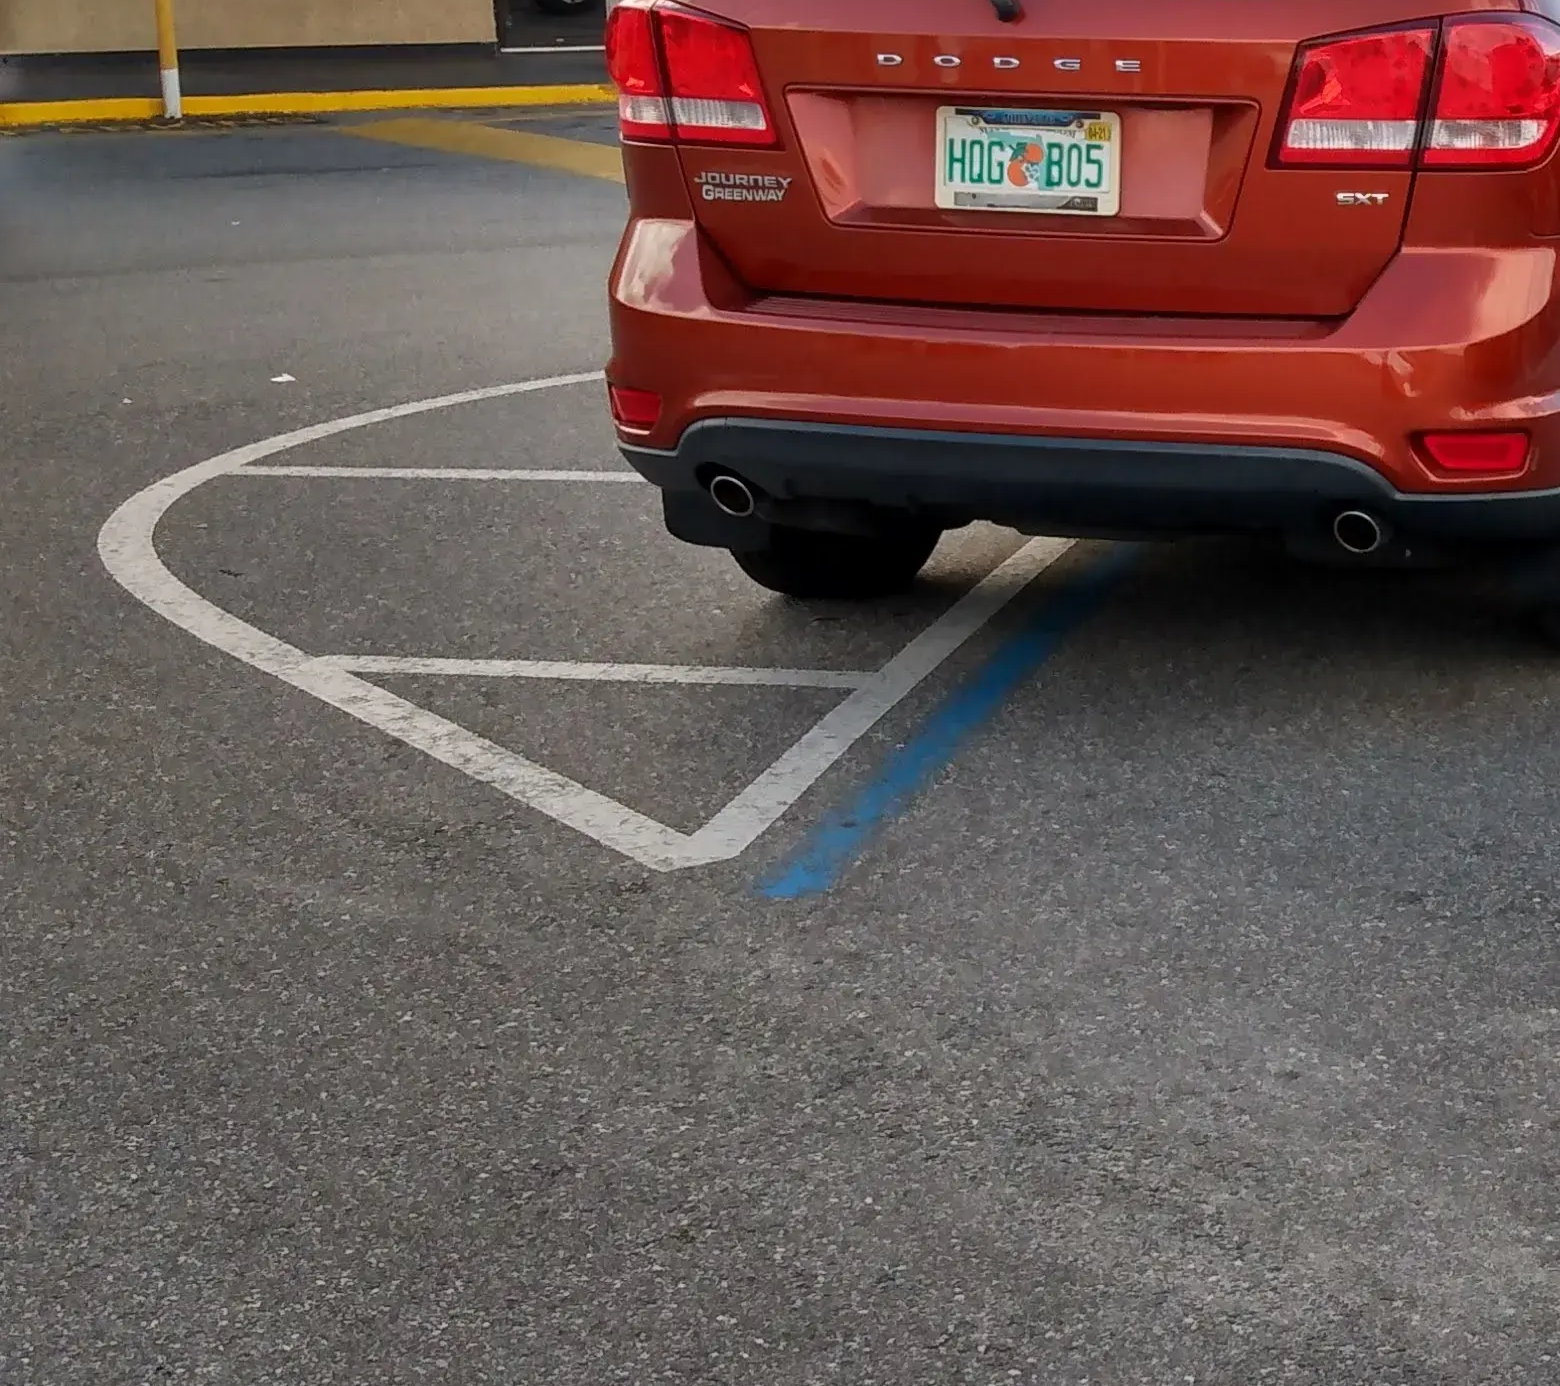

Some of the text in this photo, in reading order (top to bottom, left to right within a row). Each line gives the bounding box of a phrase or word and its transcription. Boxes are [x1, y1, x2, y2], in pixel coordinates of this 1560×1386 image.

[877, 53, 1141, 72] DODGE
[948, 138, 1005, 185] HQG
[693, 172, 792, 188] JOURNEY
[702, 184, 786, 201] GREENWAY
[1336, 192, 1389, 205] SXT
